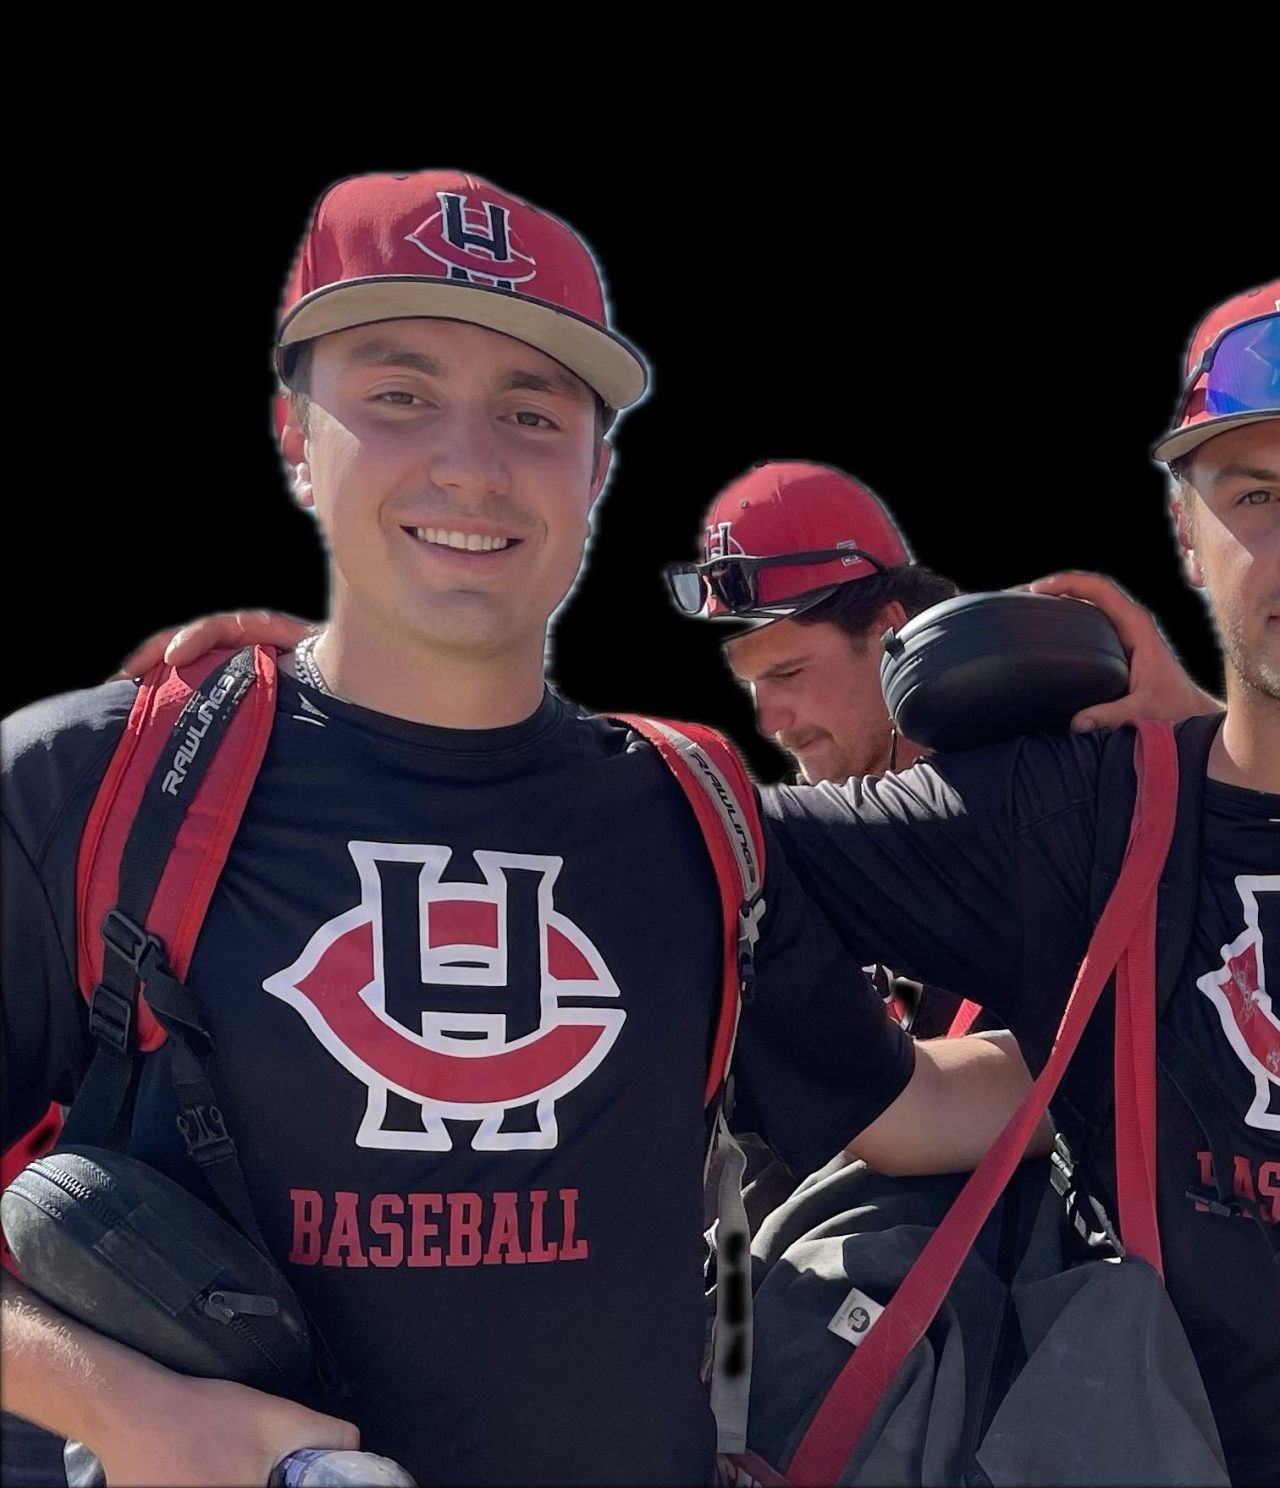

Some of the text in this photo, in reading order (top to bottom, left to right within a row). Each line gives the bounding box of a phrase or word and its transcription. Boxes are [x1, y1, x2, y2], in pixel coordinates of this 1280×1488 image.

[161, 674, 235, 796] RAWLINGS
[690, 751, 756, 883] RAWLINGS
[288, 1187, 588, 1268] BASEBALL
